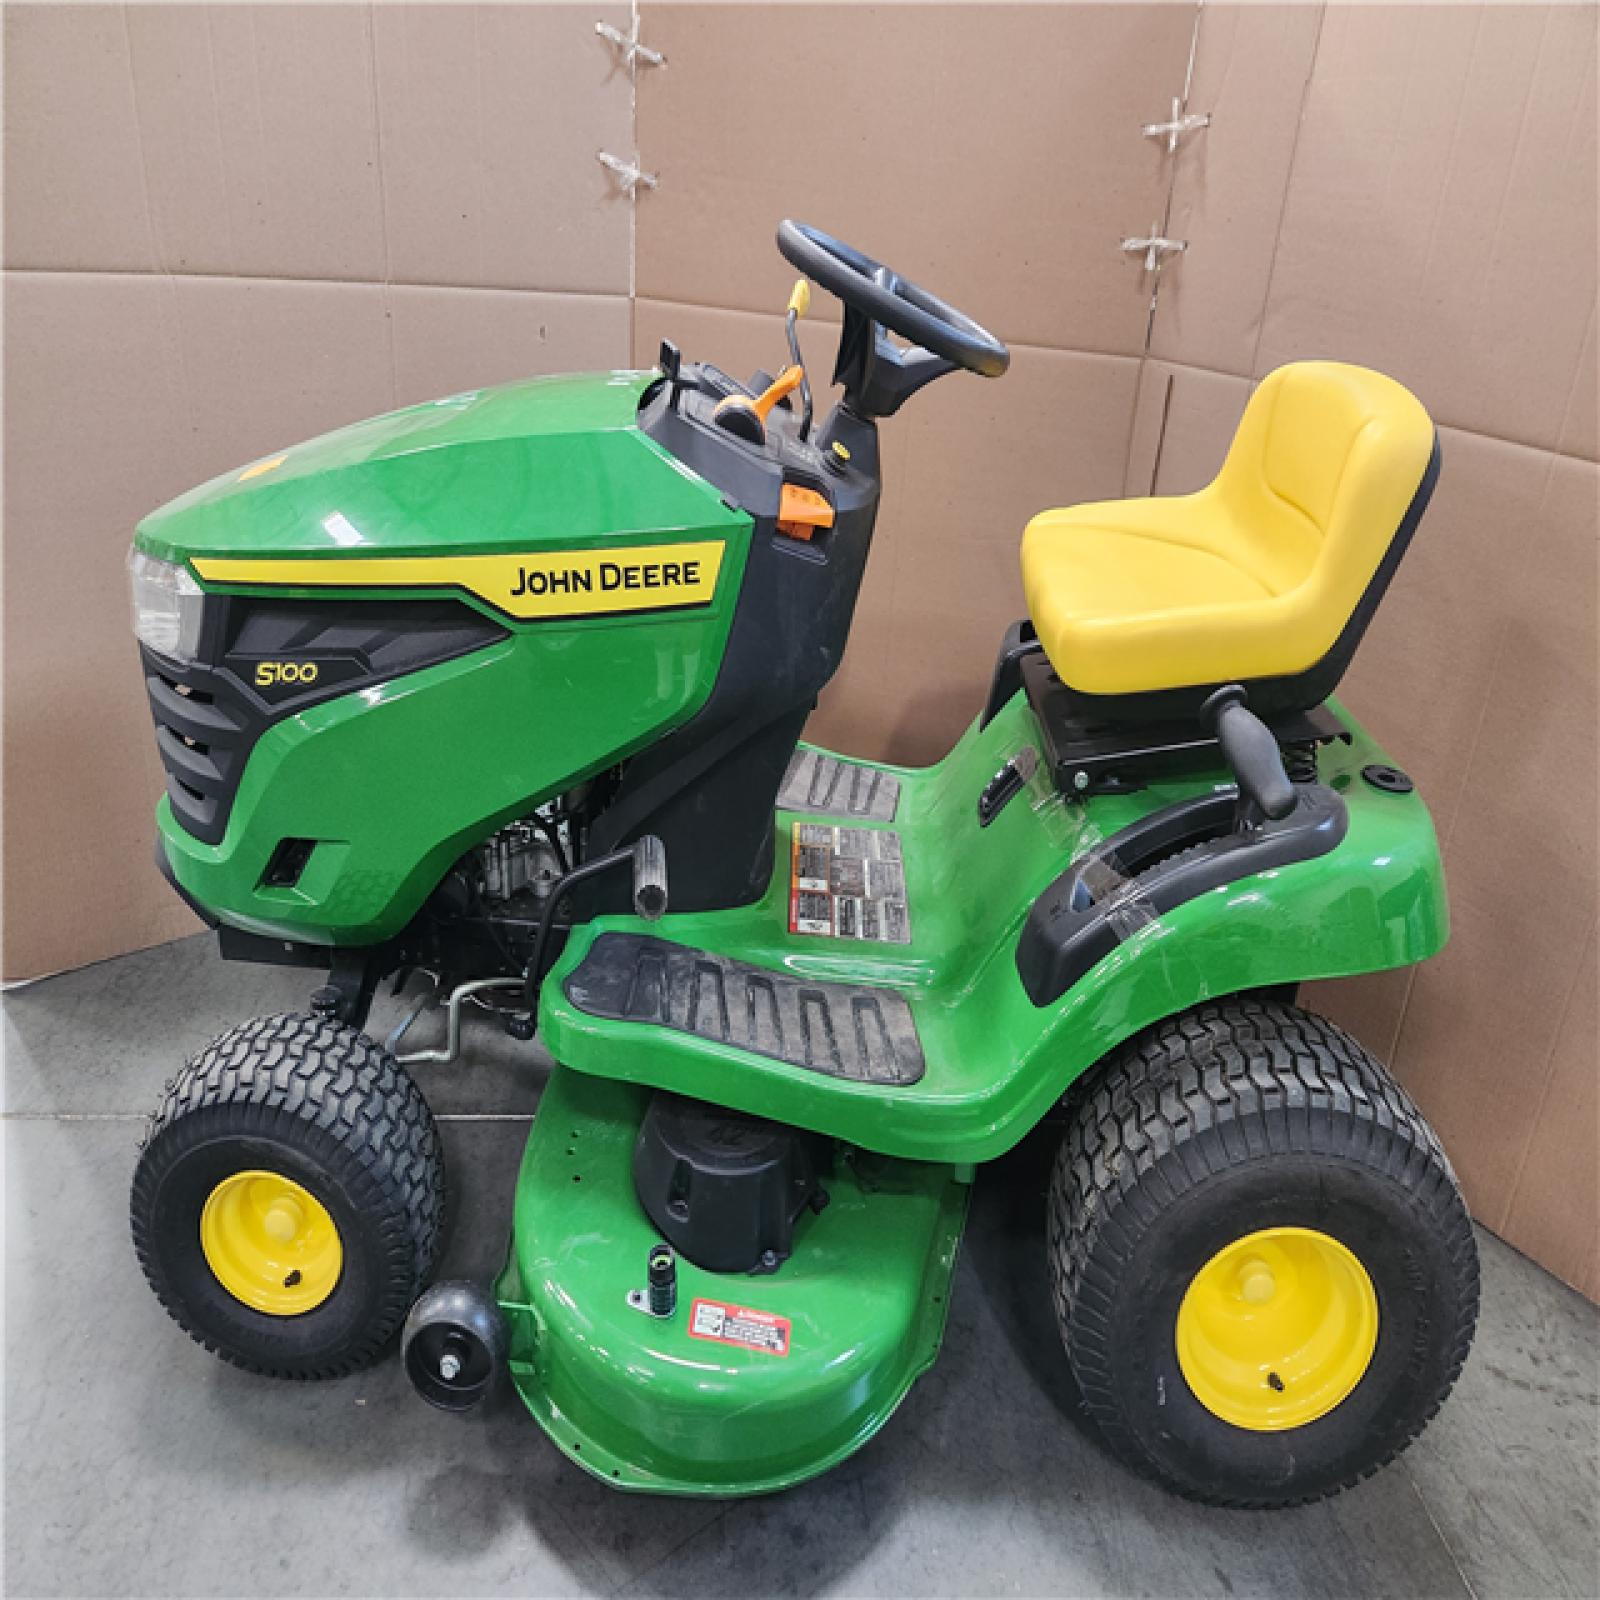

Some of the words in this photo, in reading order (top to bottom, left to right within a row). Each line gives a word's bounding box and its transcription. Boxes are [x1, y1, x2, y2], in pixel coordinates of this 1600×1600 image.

[510, 567, 592, 596] JOHN
[599, 561, 700, 591] DEERE
[255, 662, 318, 686] S100
